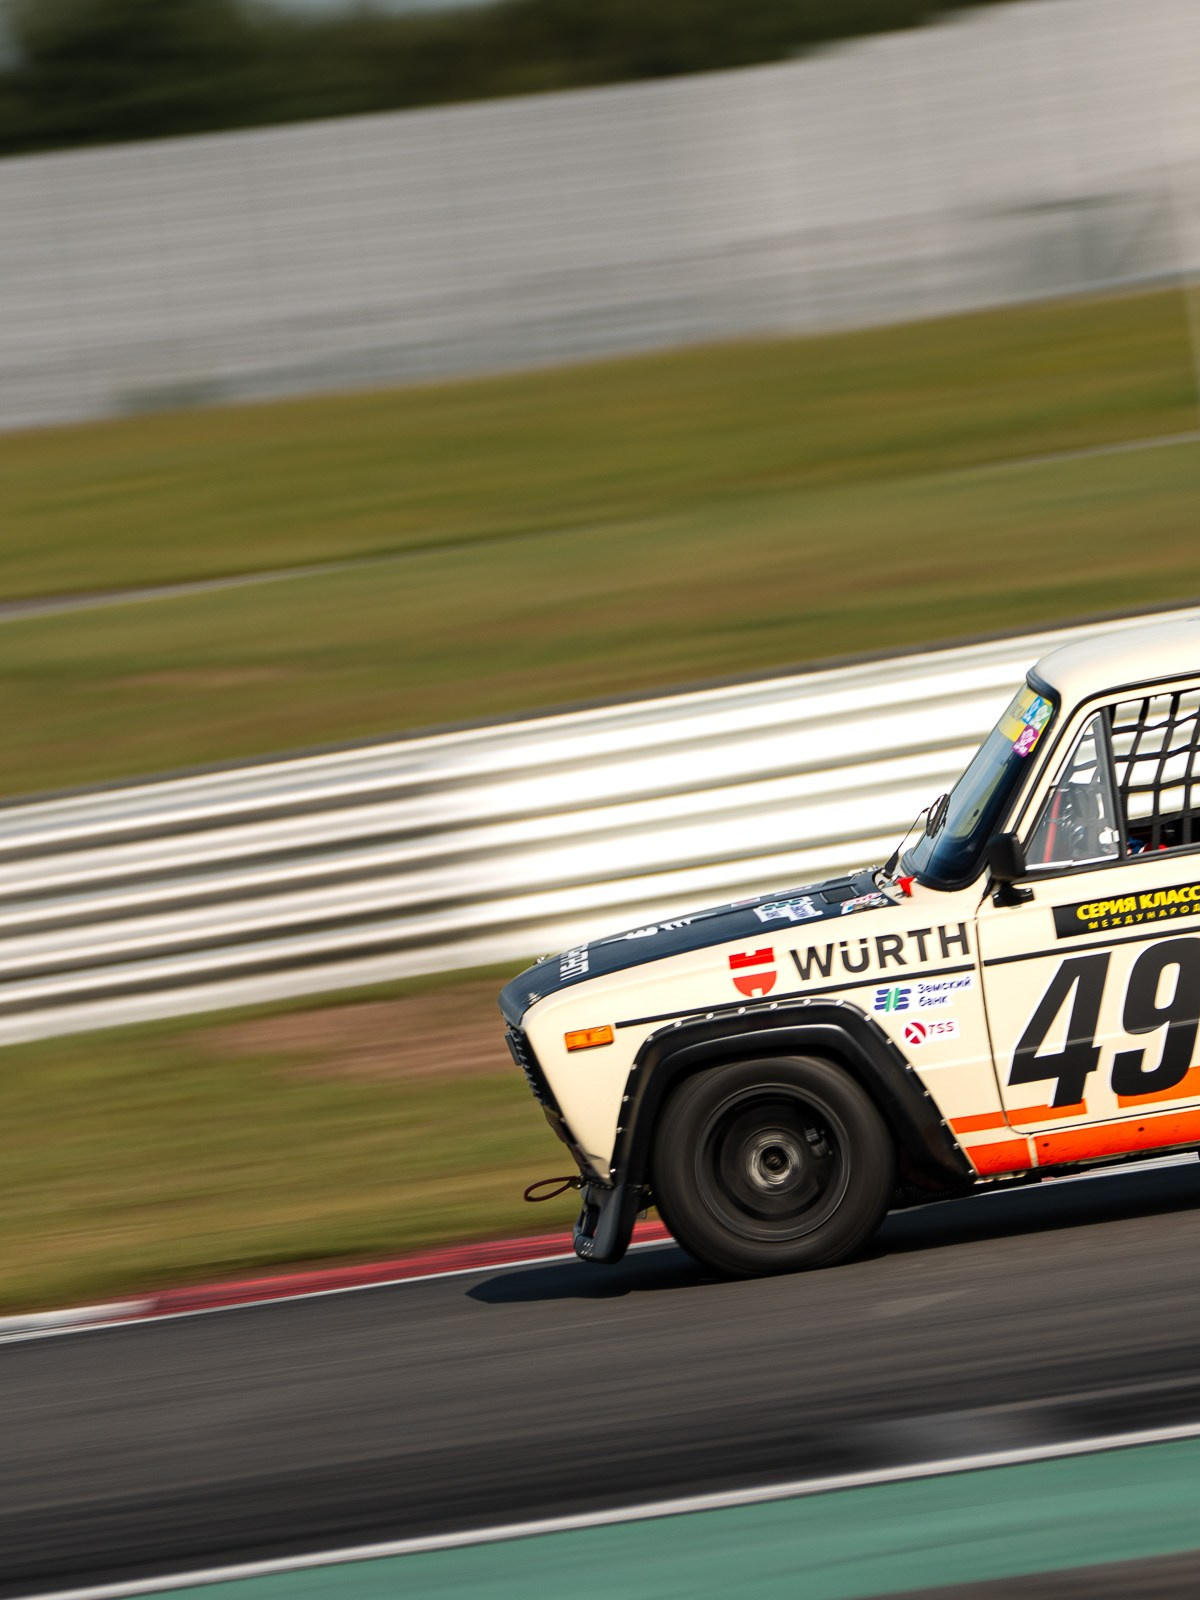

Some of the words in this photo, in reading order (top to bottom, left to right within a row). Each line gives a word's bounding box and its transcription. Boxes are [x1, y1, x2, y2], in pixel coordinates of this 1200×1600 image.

[1076, 896, 1137, 921] СЕРИЯ
[789, 922, 971, 981] WÜRTH
[917, 976, 972, 994] Земский
[928, 1021, 955, 1035] TSS
